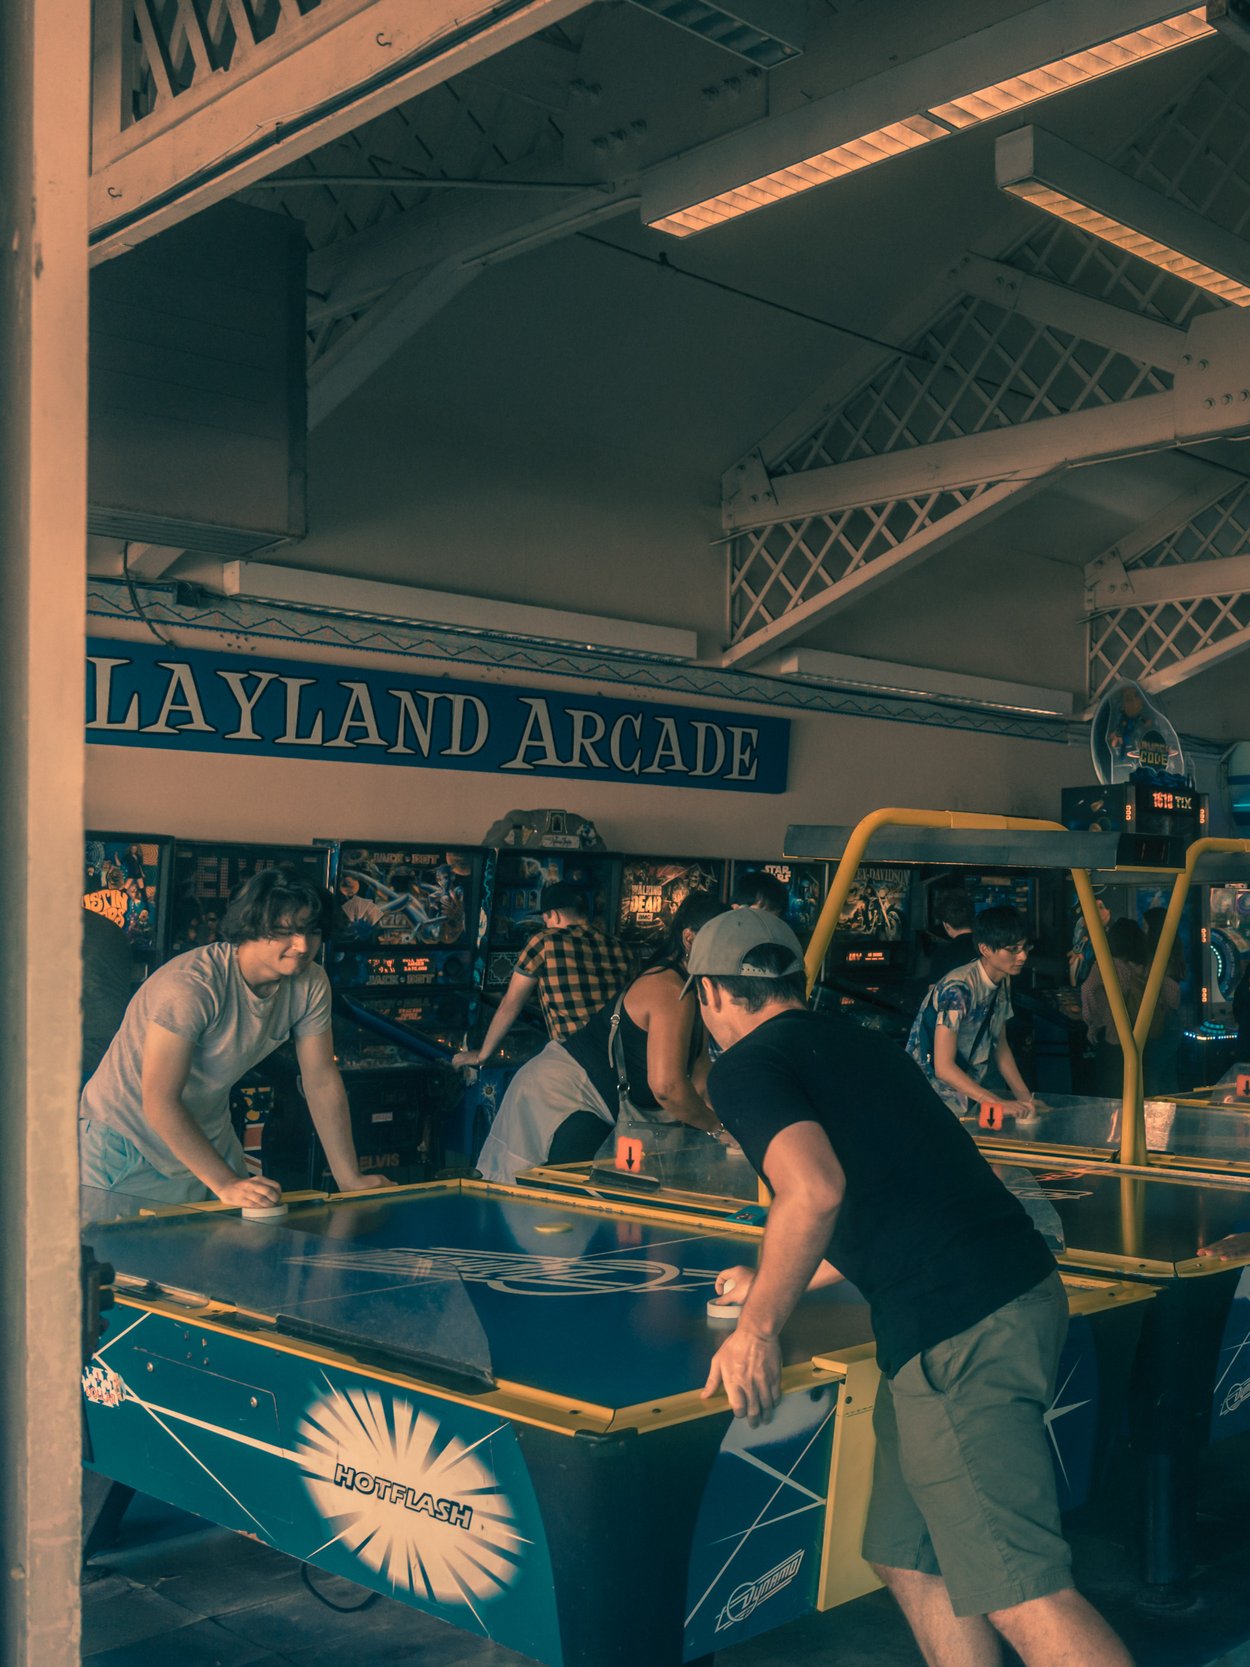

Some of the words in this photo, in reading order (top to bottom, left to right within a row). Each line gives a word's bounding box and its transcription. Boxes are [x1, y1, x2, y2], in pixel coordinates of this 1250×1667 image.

[86, 656, 490, 758] LAYLAND
[499, 697, 760, 781] ARCADE
[760, 864, 790, 875] STAR
[629, 895, 662, 913] DEAD
[359, 1152, 401, 1171] ELVIS
[333, 1462, 474, 1531] HOTFLASH
